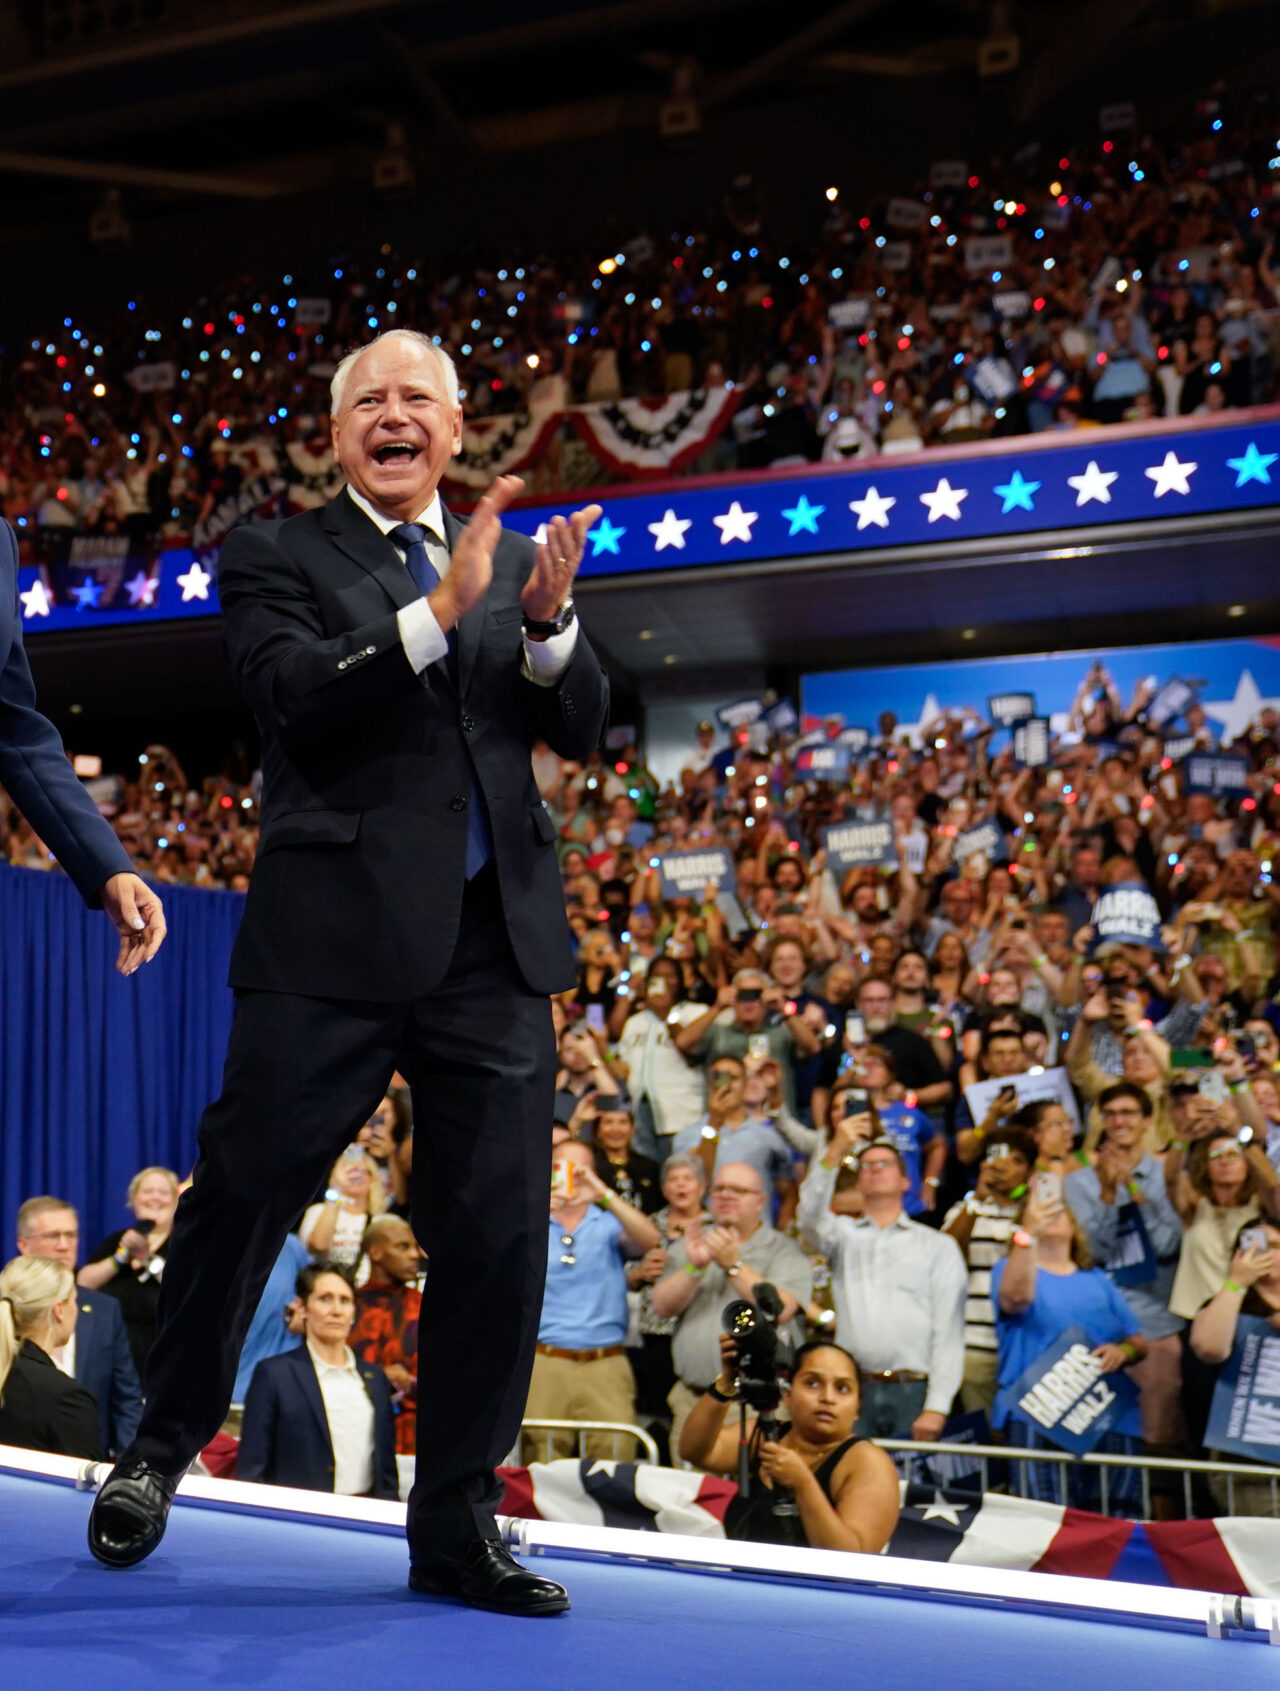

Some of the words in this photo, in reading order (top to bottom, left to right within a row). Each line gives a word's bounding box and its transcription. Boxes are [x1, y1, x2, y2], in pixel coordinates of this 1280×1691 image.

[827, 823, 892, 850] HARRIS
[663, 853, 727, 881] HARRIS
[1019, 1343, 1104, 1430] HARRIS
[1060, 1380, 1117, 1436] WALZ
